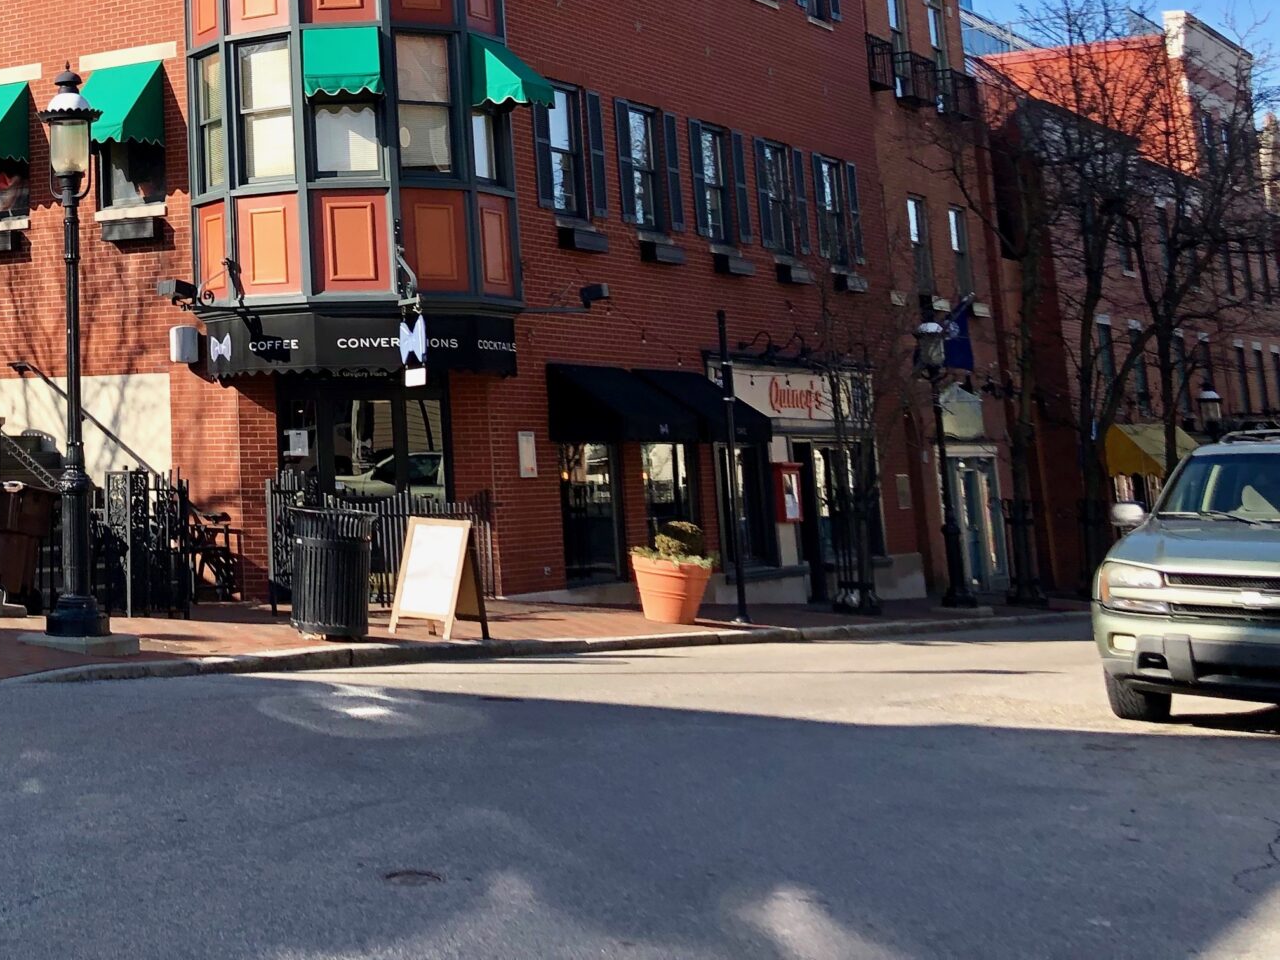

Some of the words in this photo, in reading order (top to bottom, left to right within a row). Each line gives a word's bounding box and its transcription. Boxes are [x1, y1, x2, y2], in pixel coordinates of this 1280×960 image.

[249, 339, 299, 351] COFFEE
[337, 337, 458, 349] CONVERIONS
[477, 339, 517, 352] COCKTAILS
